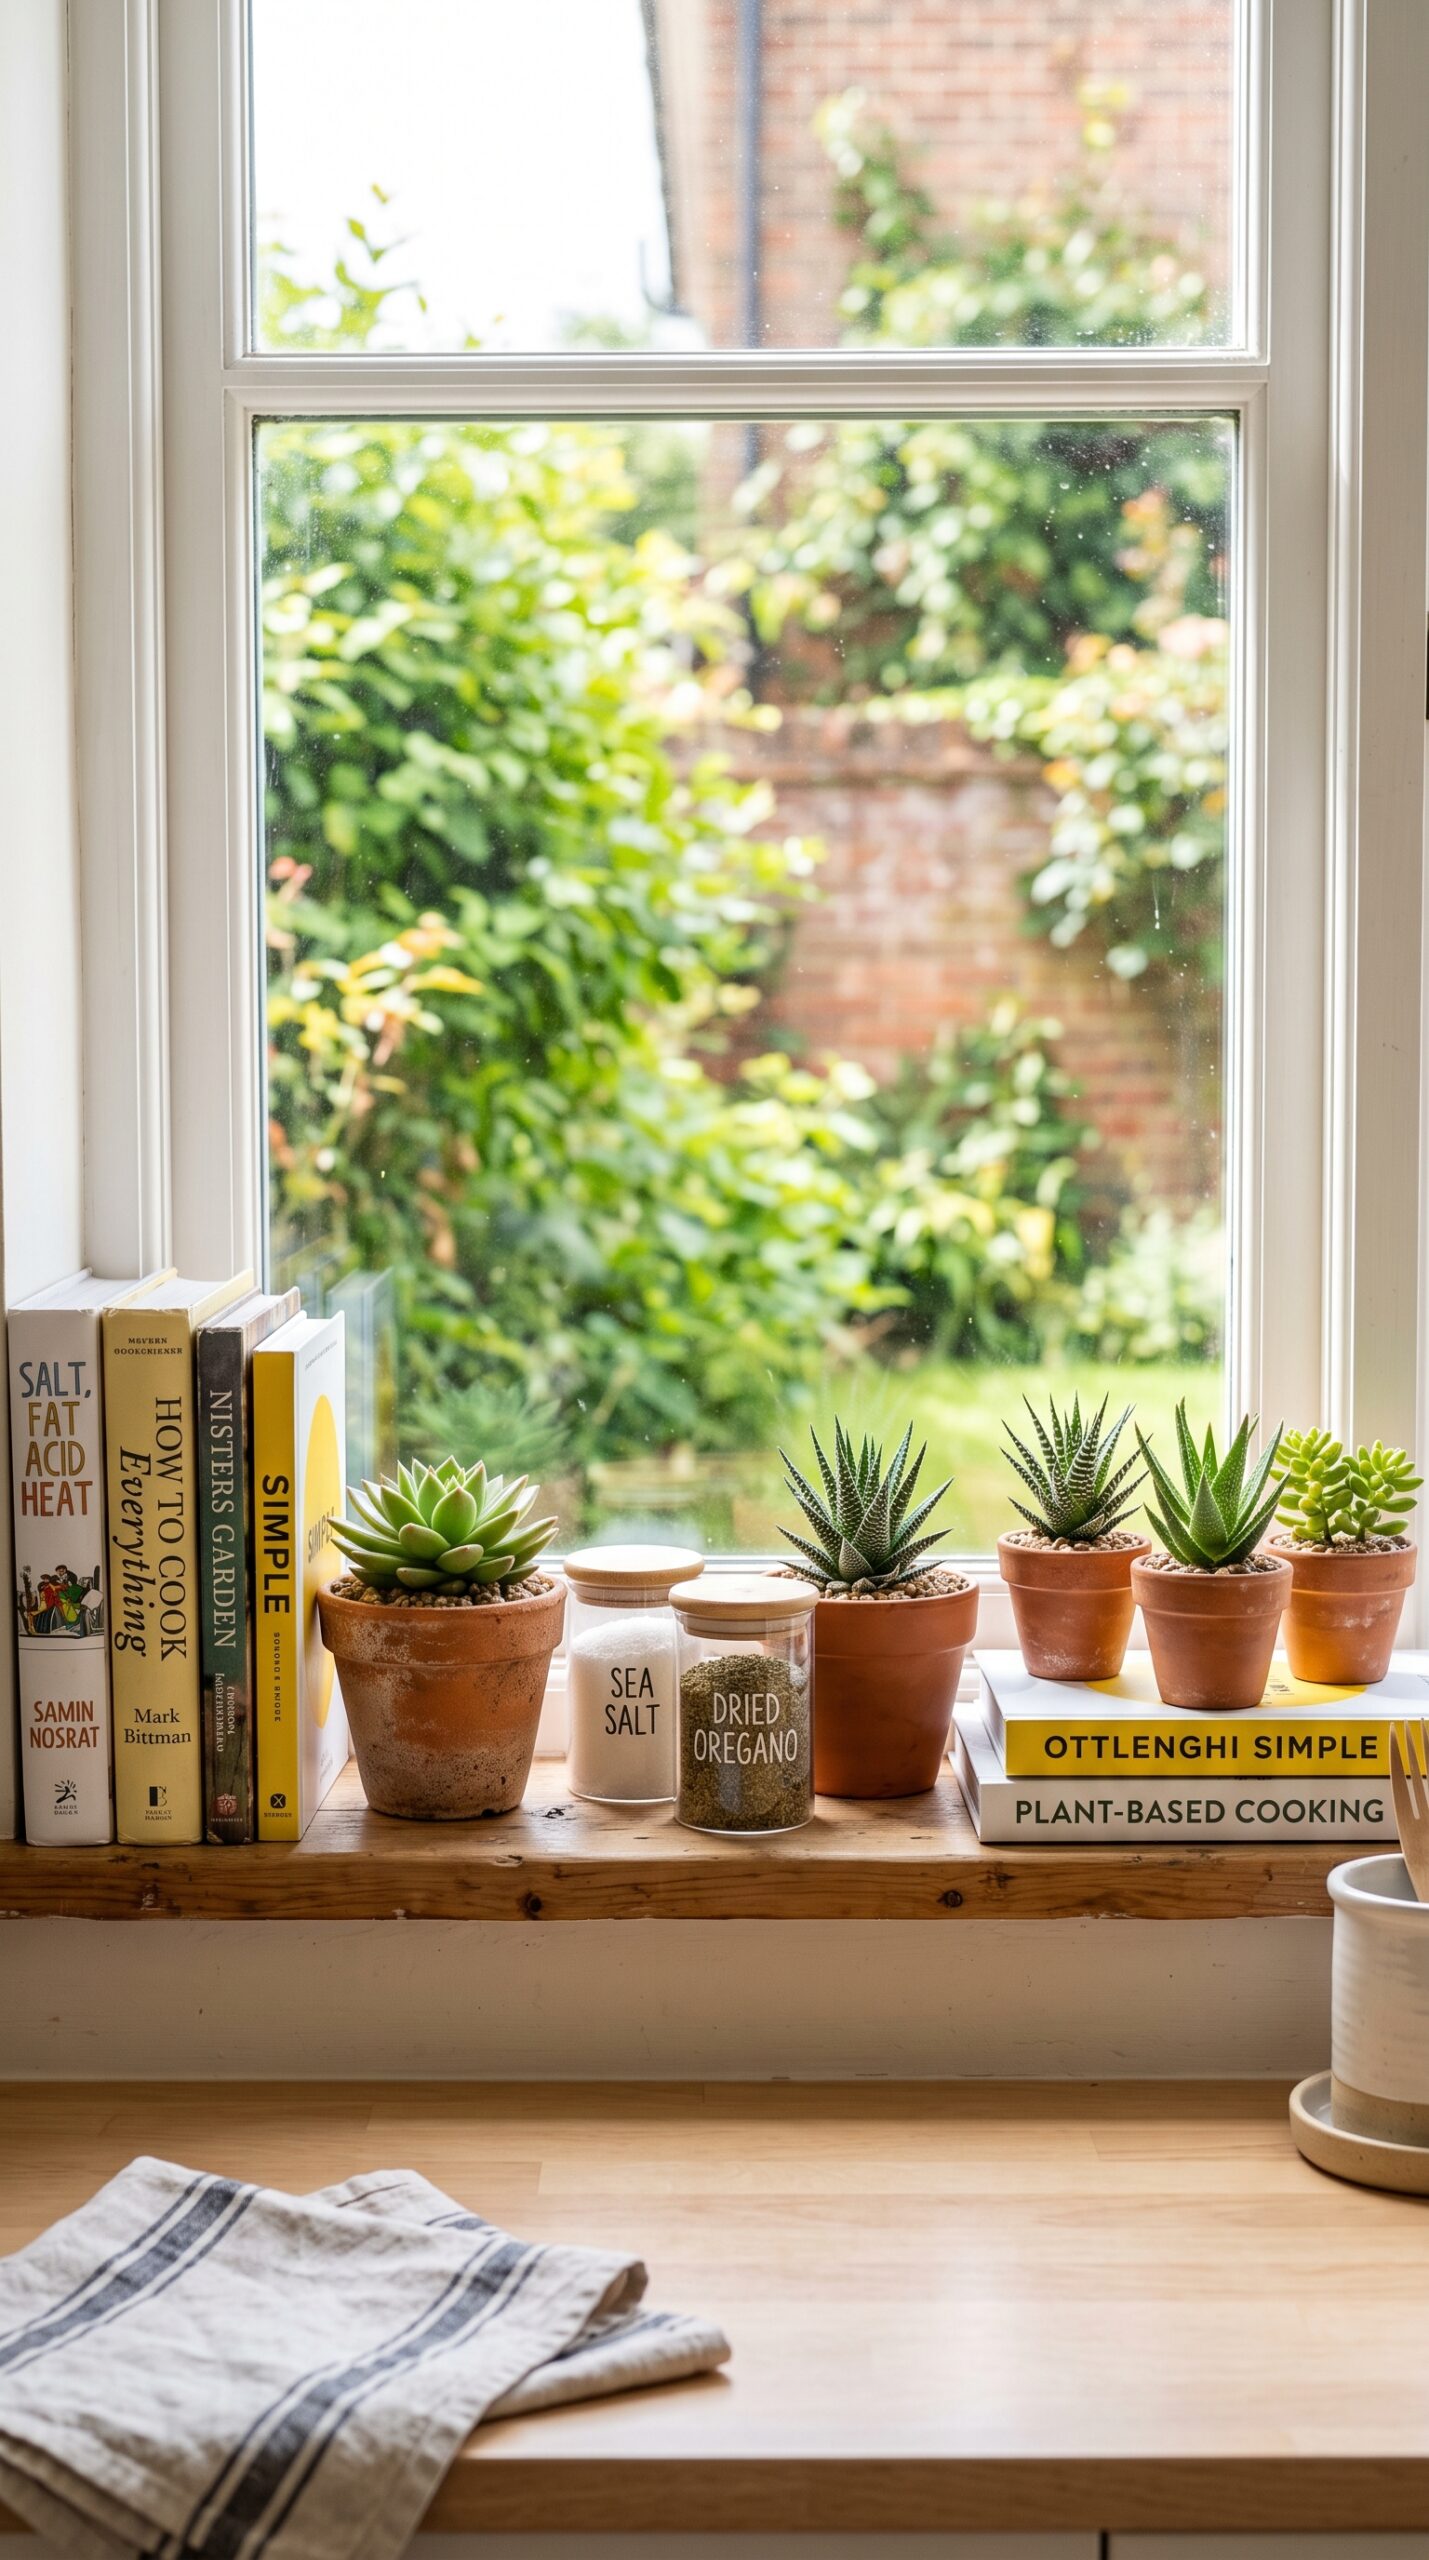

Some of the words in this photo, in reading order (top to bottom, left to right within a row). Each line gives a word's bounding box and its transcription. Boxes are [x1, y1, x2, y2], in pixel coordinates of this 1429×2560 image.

[19, 1361, 92, 1399] SALT,
[28, 1401, 80, 1437] FAT
[25, 1440, 86, 1477] ACID
[155, 1396, 183, 1485] HOW
[209, 1389, 235, 1514] NISTERS
[21, 1480, 93, 1517] HEAT
[157, 1492, 185, 1544] TO
[112, 1445, 156, 1658] Everything
[262, 1475, 290, 1614] SIMPLE
[211, 1524, 237, 1649] GARDEN
[158, 1555, 187, 1662] COOK
[610, 1666, 654, 1699] SEA
[34, 1700, 94, 1722] SAMIN
[134, 1708, 181, 1724] Mark
[604, 1703, 661, 1736] SALT
[713, 1692, 780, 1726] DRIED
[30, 1726, 100, 1748] NOSRAT
[123, 1728, 192, 1745] Bittman
[694, 1728, 798, 1765] OREGANO
[1044, 1735, 1238, 1759] OTTLENGHI
[1253, 1735, 1378, 1759] SIMPLE
[1016, 1799, 1225, 1824] PLANT-BASED
[1235, 1799, 1384, 1824] COOKING
